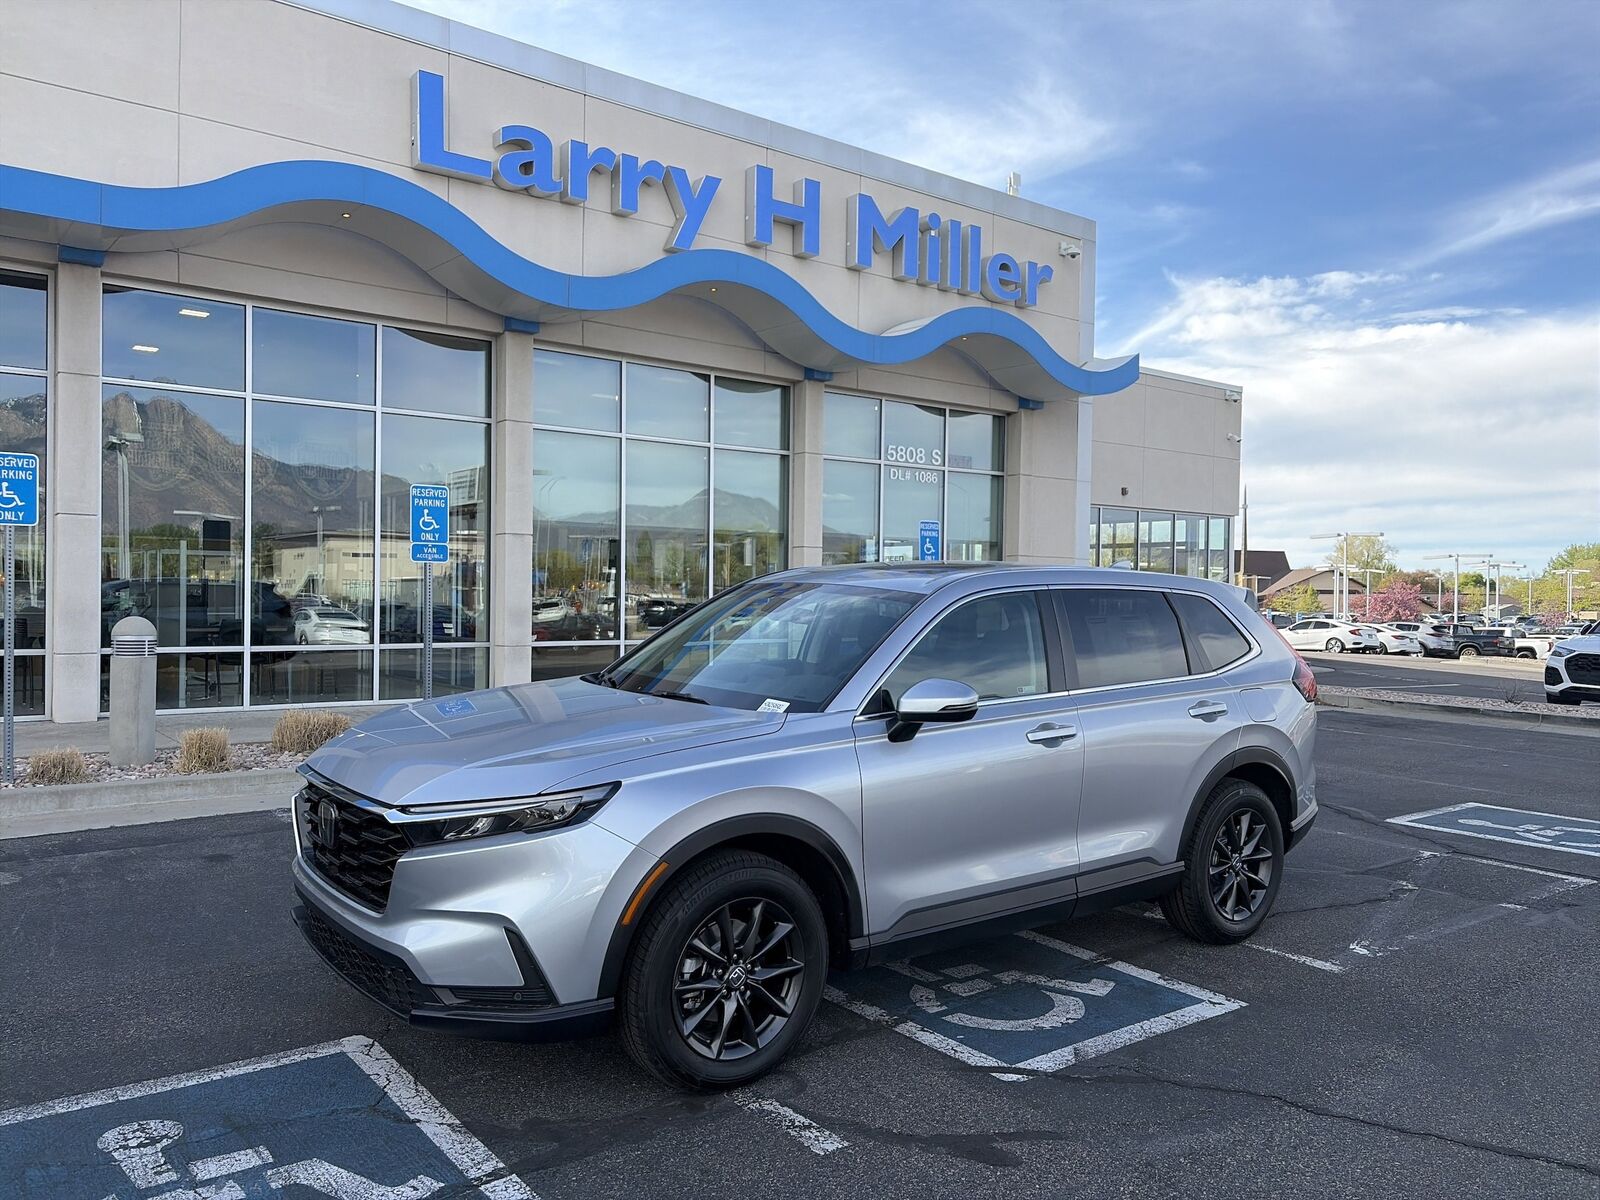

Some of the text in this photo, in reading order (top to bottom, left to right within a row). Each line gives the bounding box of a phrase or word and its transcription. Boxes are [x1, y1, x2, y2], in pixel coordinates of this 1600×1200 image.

[411, 69, 1053, 307] Larry H Miller
[887, 445, 925, 464] 5808
[932, 449, 942, 465] S
[0, 469, 33, 480] RKING
[890, 469, 938, 484] DL# 1086
[412, 488, 447, 498] RESERVED
[414, 498, 445, 508] PARKING
[420, 532, 439, 541] ONLY
